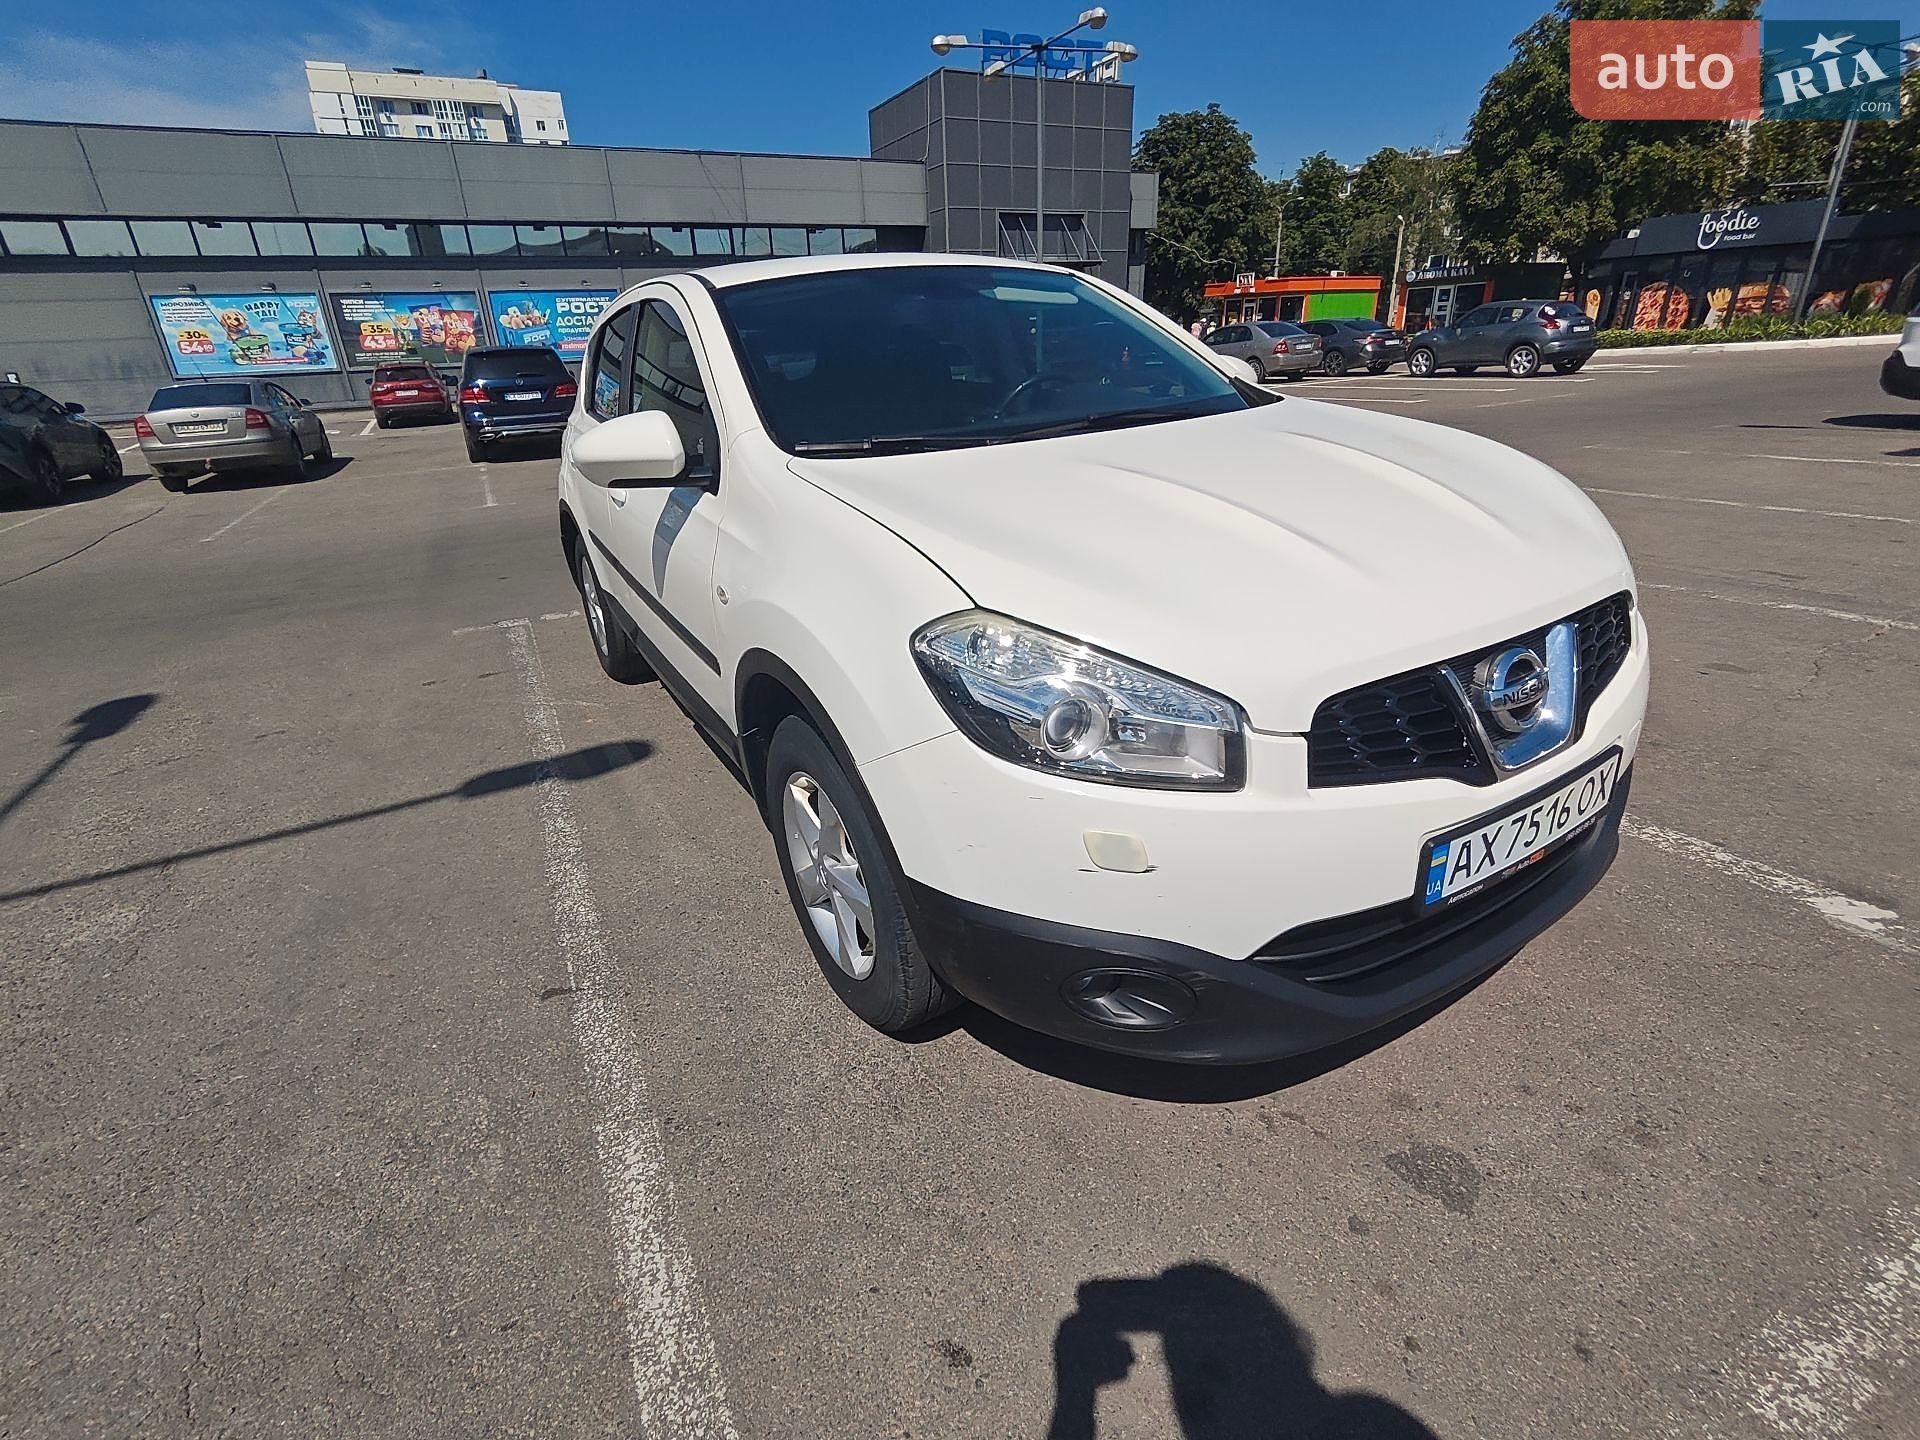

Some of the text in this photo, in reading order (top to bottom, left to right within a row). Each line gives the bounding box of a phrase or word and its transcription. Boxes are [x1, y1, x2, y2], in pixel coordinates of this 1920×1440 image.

[1697, 210, 1761, 250] foodie
[1742, 232, 1756, 240] bar
[244, 301, 280, 312] HAPPY
[556, 302, 612, 314] РОСТ
[364, 336, 387, 349] 43
[523, 332, 551, 344] РОСТ
[179, 341, 204, 354] 54
[1448, 825, 1504, 887] AX
[1505, 788, 1571, 861] 7516
[1577, 761, 1614, 817] OX
[1426, 881, 1442, 897] UA
